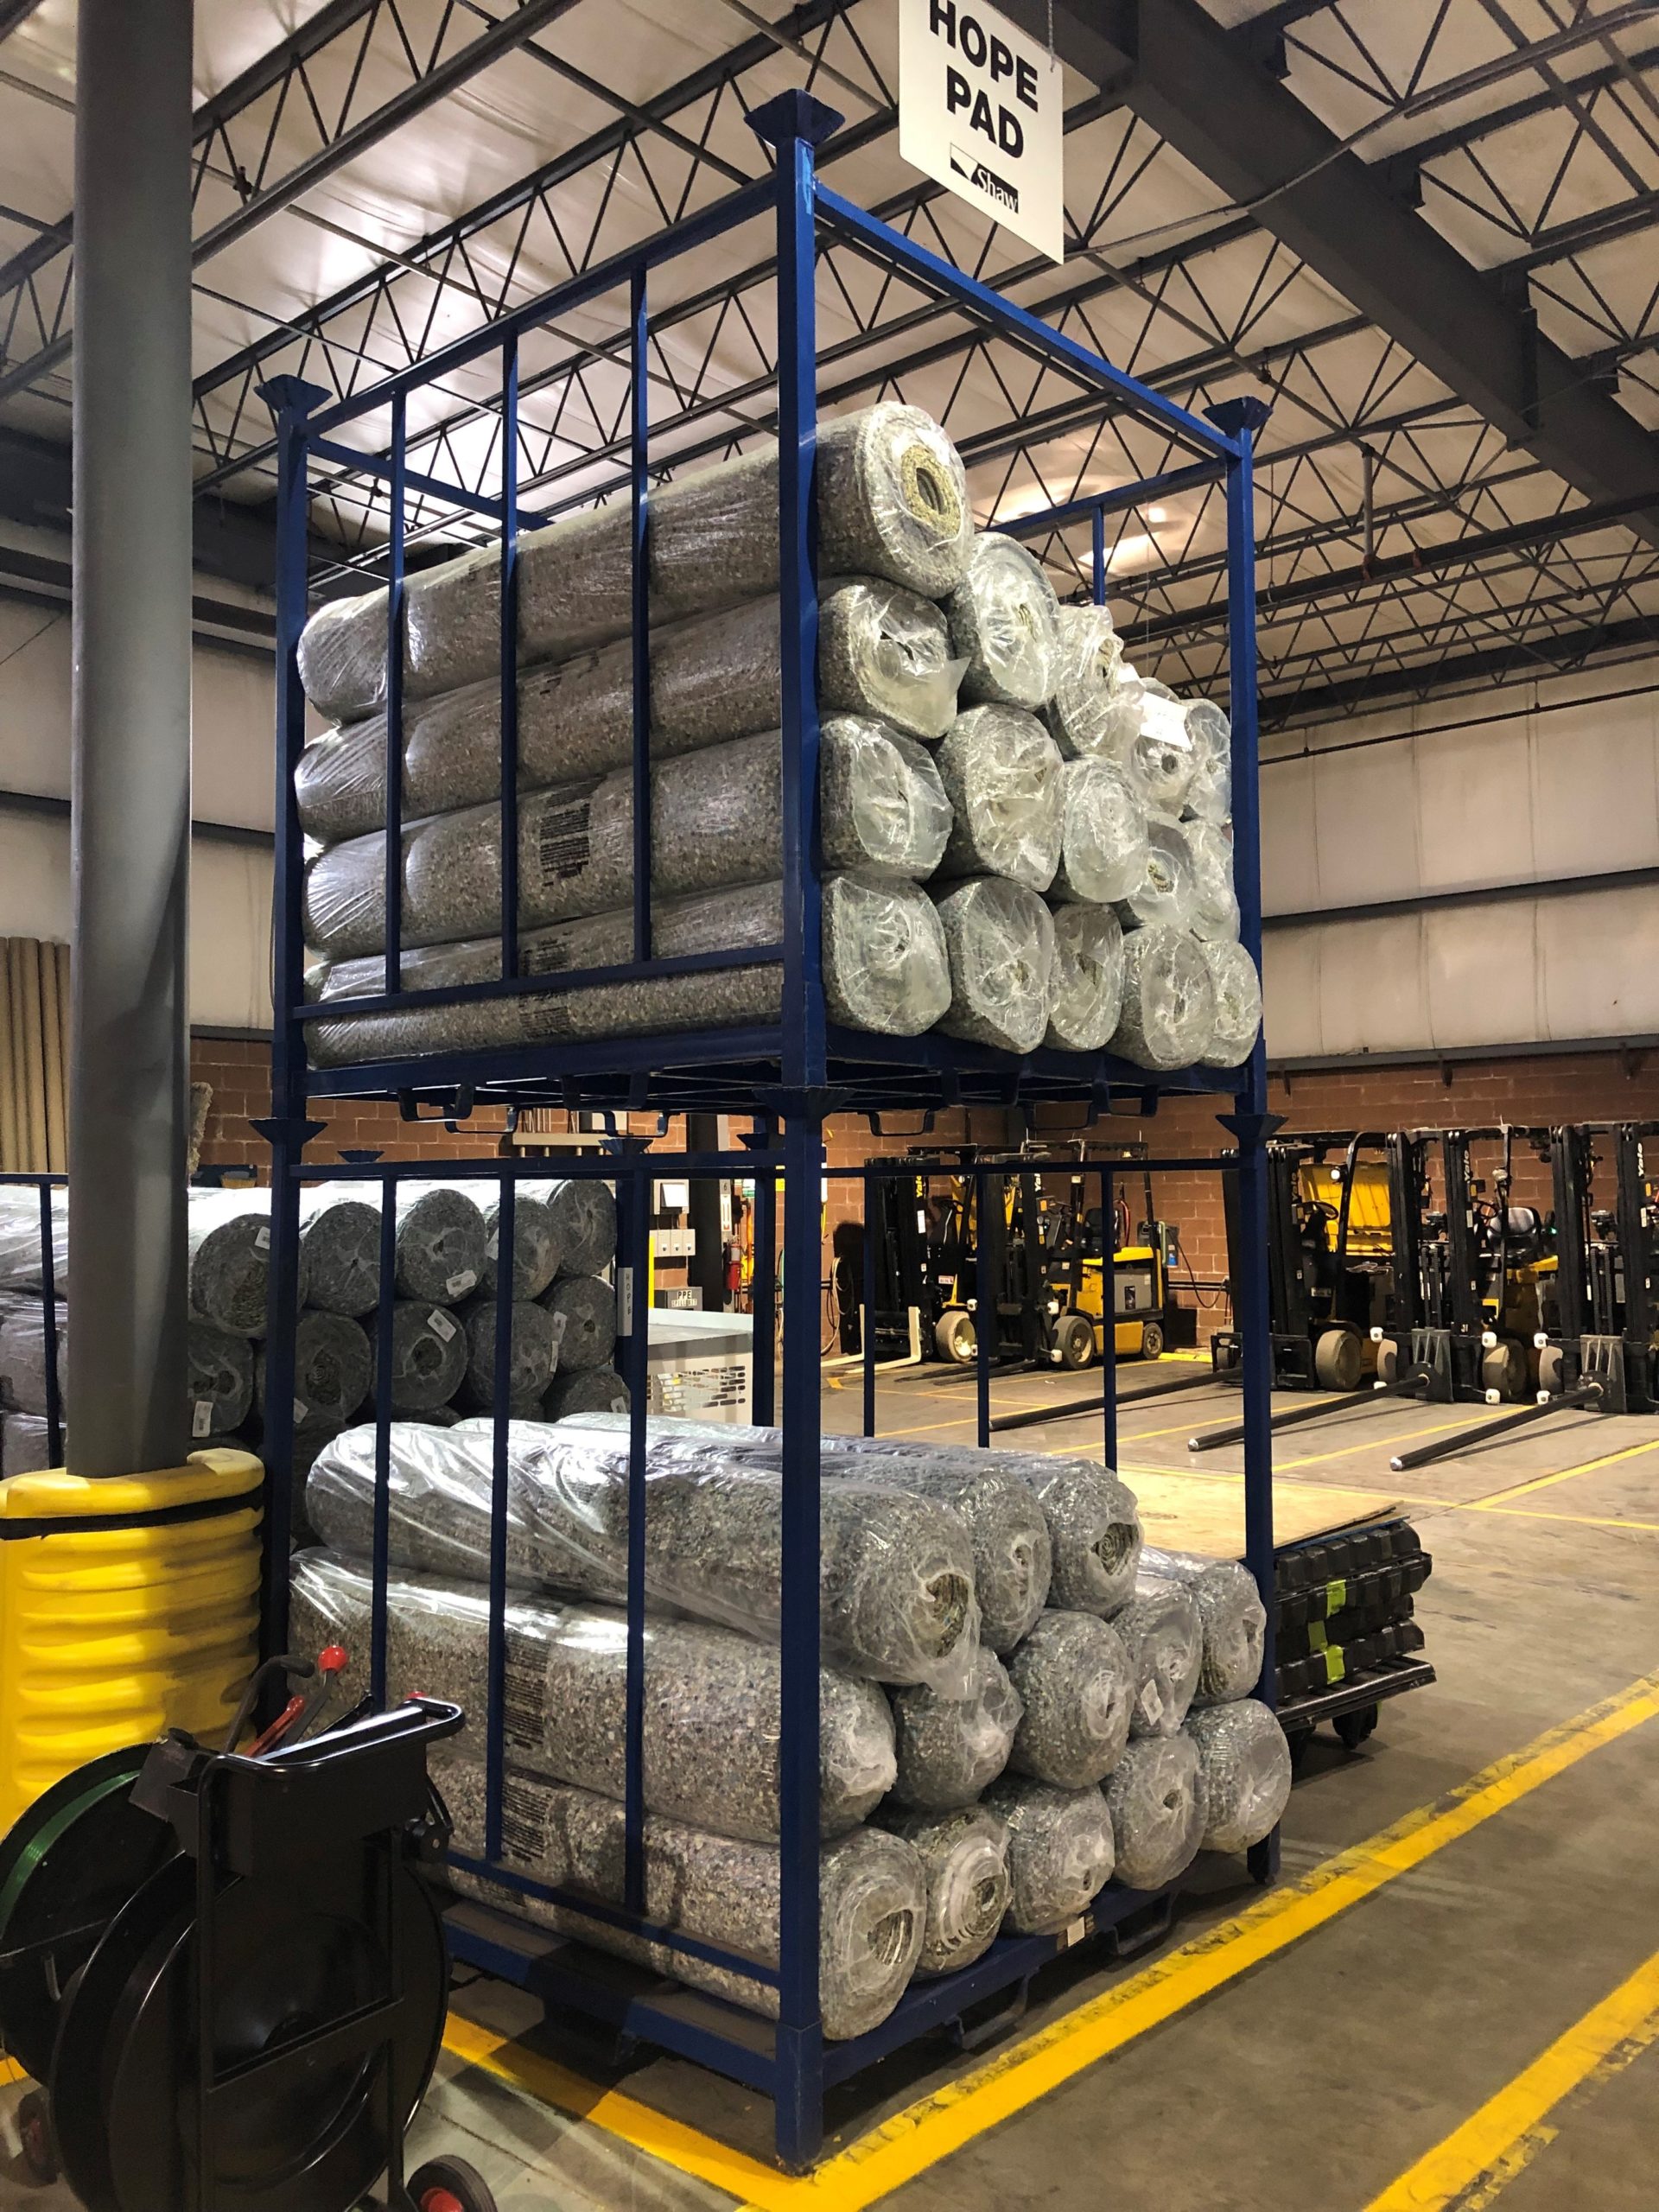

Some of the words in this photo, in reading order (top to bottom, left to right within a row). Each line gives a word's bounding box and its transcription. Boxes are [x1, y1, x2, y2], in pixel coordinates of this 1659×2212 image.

[930, 0, 1038, 112] HOPE
[947, 65, 1024, 158] PAD
[976, 168, 1018, 213] Shaw
[678, 1290, 691, 1300] PPE
